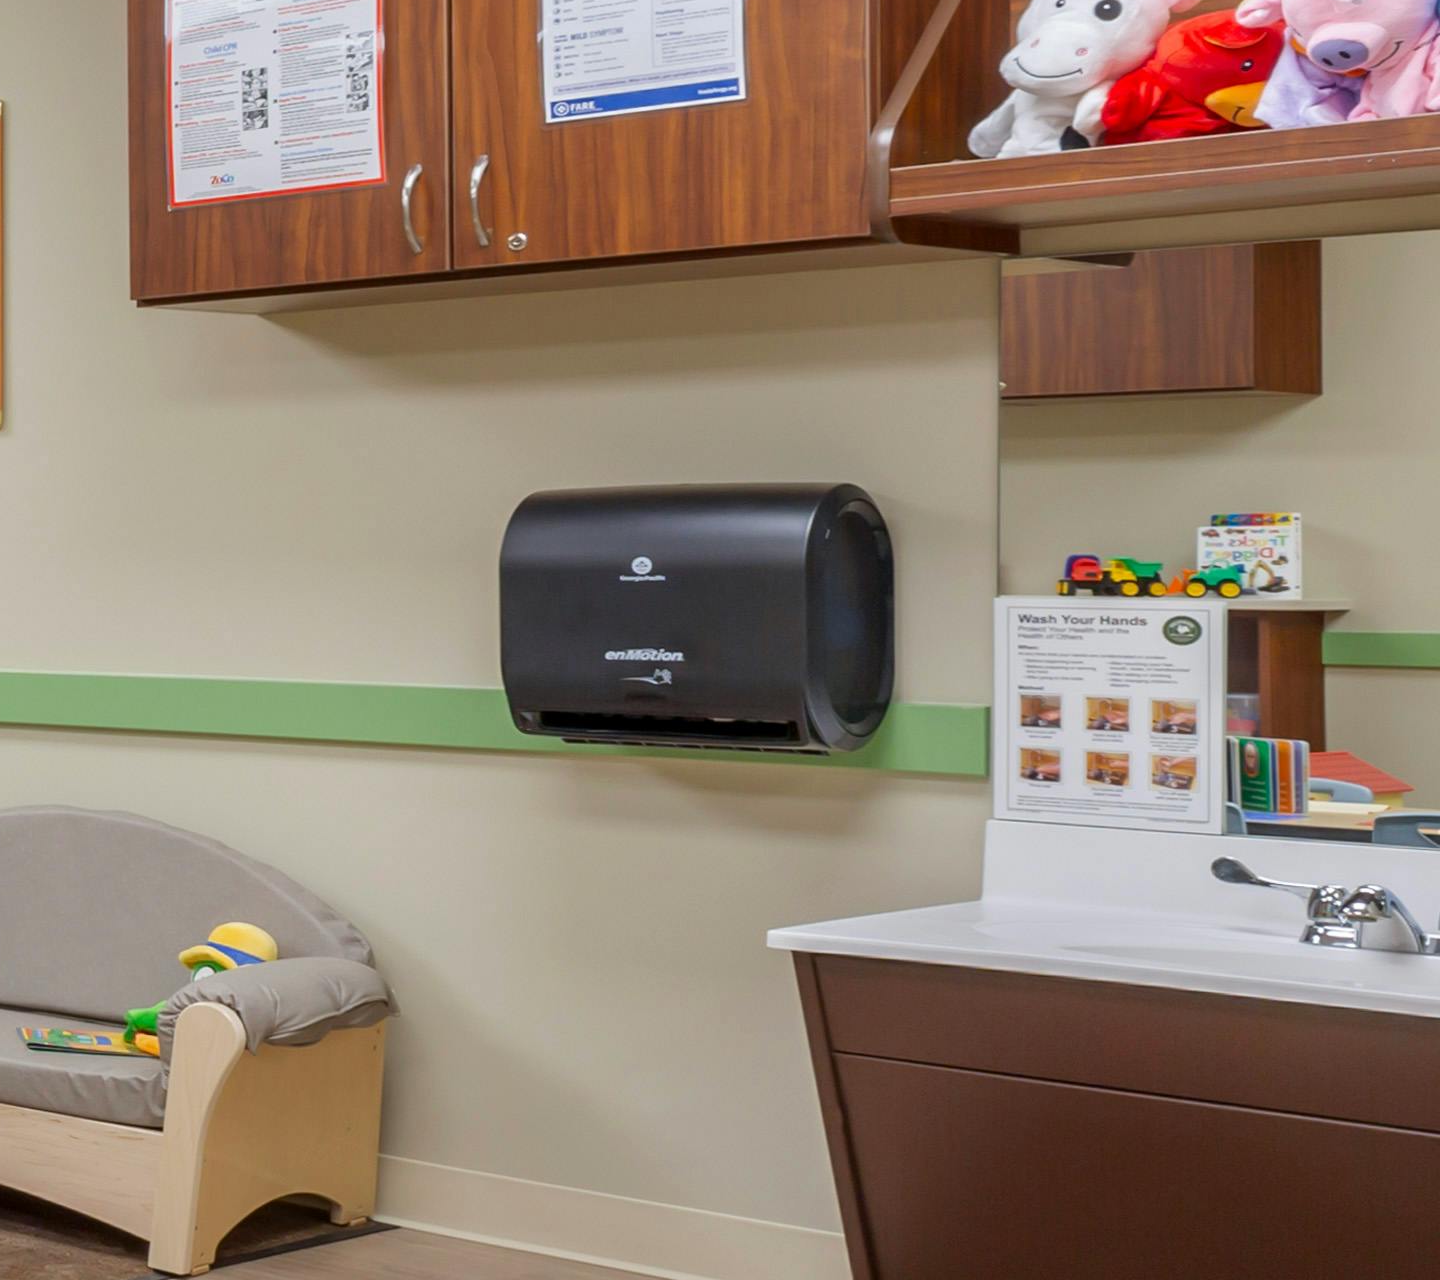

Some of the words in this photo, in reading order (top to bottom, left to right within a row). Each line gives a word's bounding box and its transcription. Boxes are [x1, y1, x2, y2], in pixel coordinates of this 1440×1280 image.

[204, 43, 223, 55] Child
[1018, 614, 1057, 625] Wash
[1061, 614, 1095, 626] Your
[1100, 615, 1148, 627] Hands
[1048, 626, 1067, 634] Your
[1056, 633, 1084, 641] Others
